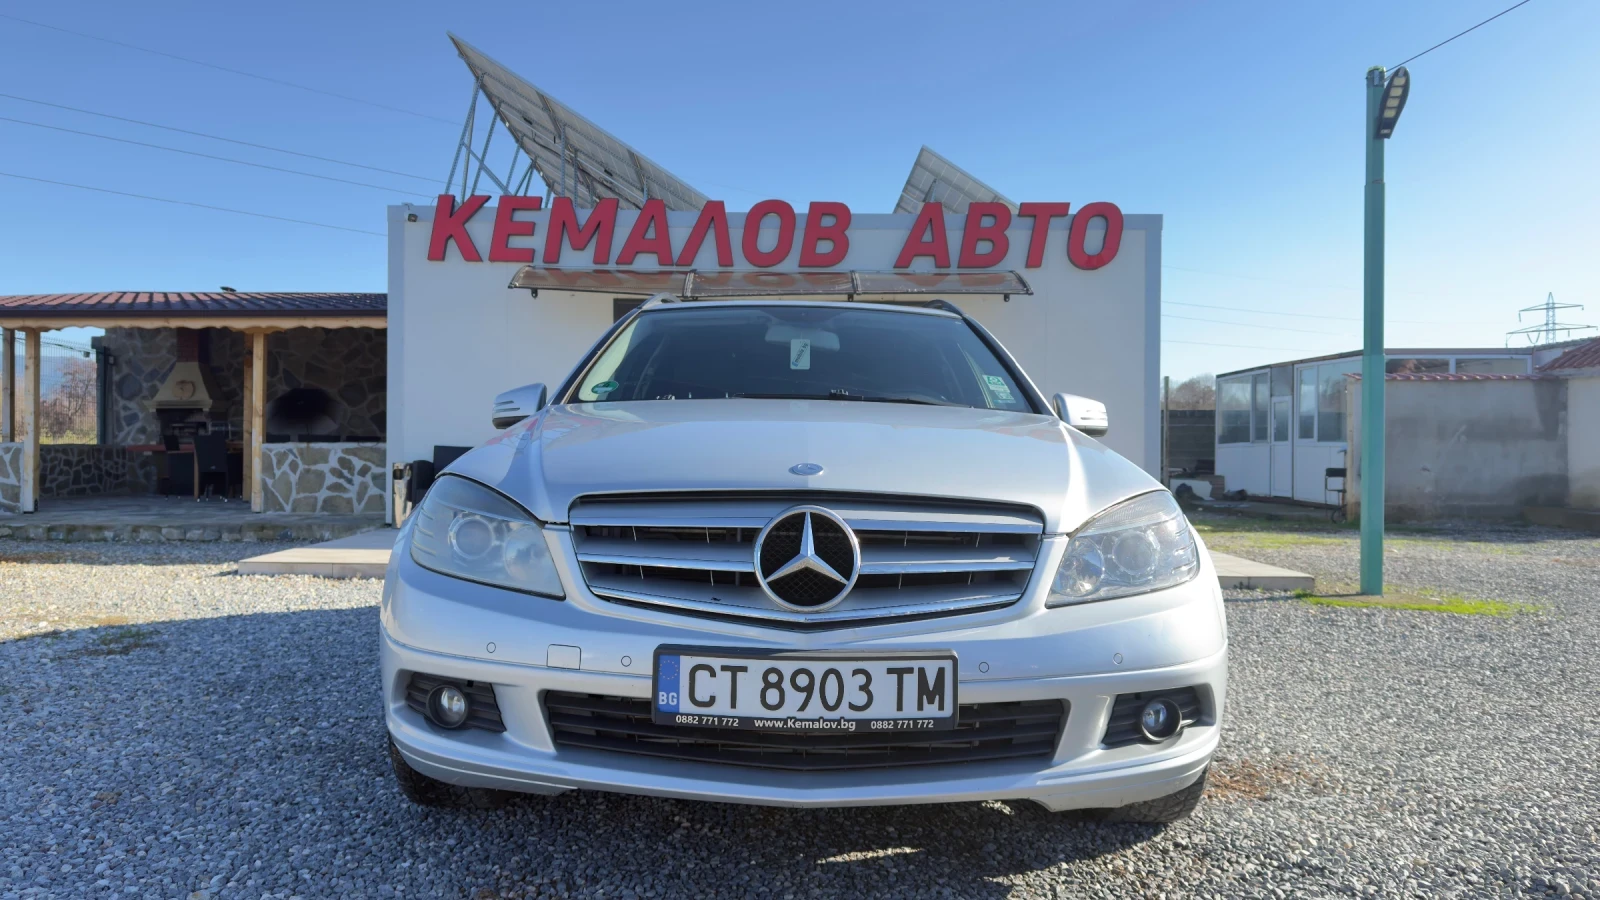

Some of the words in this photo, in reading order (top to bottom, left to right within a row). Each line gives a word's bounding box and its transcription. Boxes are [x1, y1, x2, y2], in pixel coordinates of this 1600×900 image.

[427, 194, 851, 269] КЕМАЛОВ
[893, 201, 1125, 271] АВТО
[759, 667, 874, 712] 8903
[886, 667, 945, 712] TM
[659, 691, 678, 706] BG
[676, 715, 699, 724] 0882
[701, 716, 720, 725] 771
[721, 717, 739, 727] 772
[754, 717, 856, 731] www.Kemalov.bg
[870, 720, 894, 730] 0882
[897, 720, 915, 729] 771
[916, 719, 934, 728] 772
